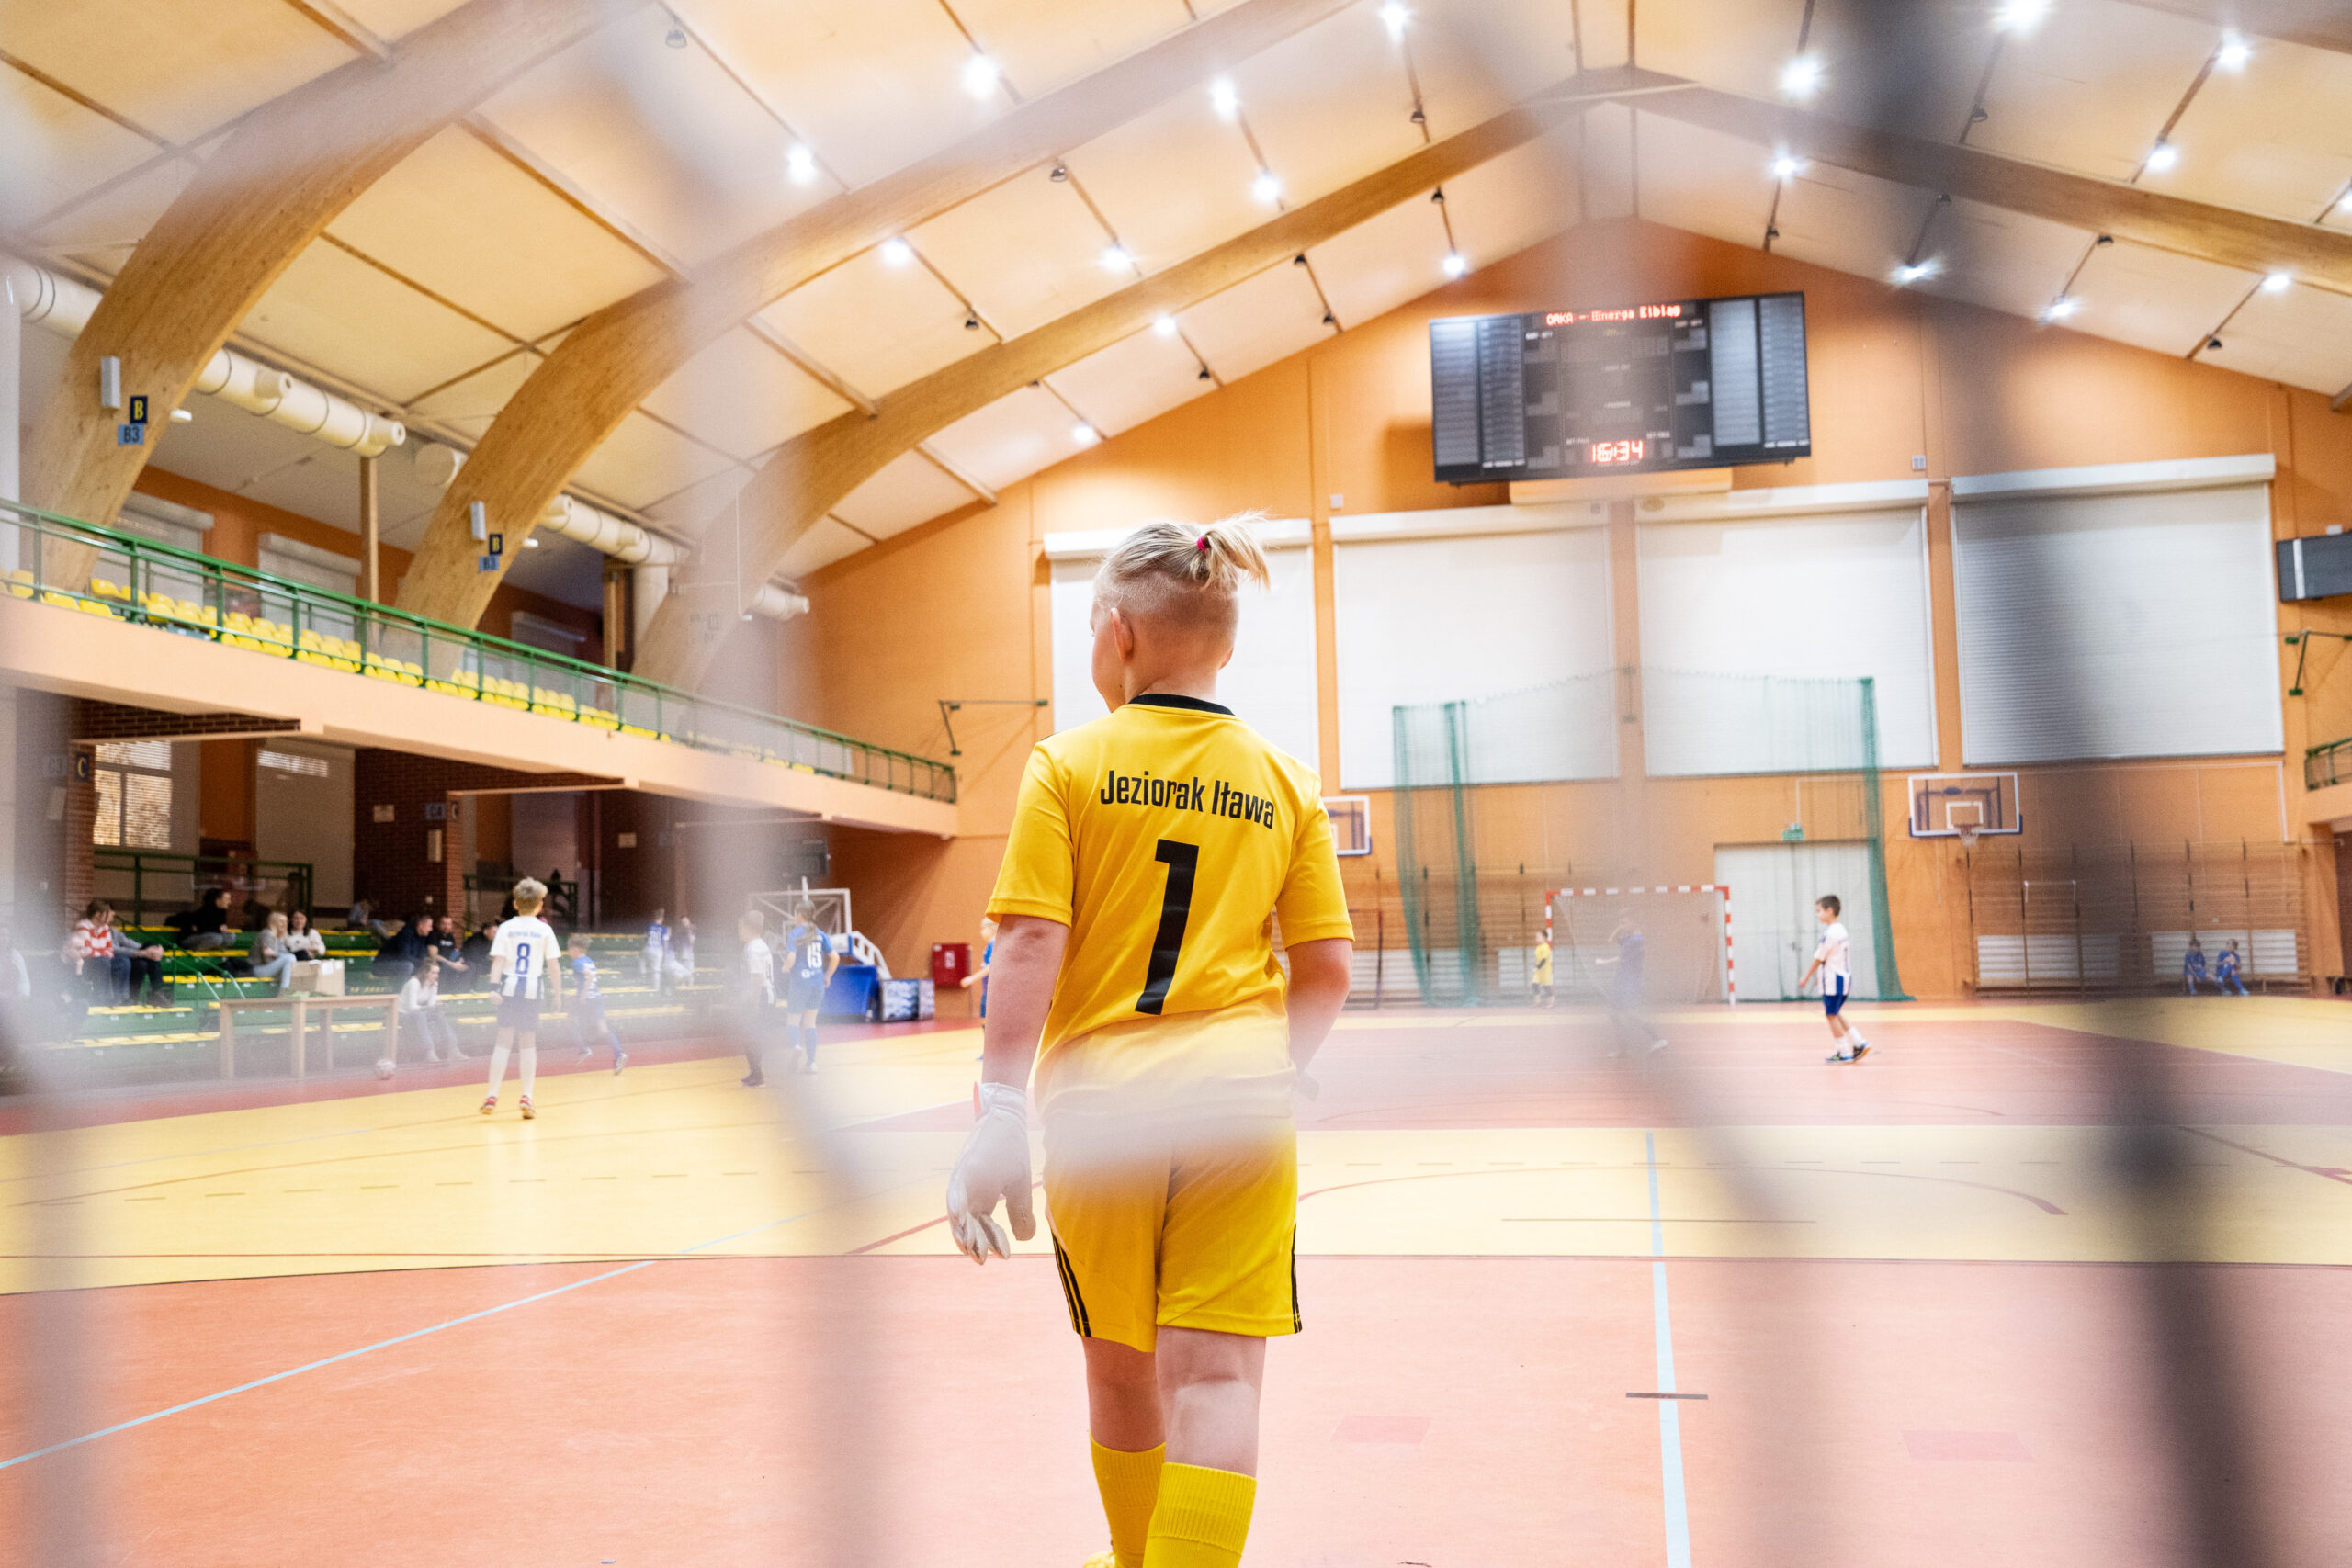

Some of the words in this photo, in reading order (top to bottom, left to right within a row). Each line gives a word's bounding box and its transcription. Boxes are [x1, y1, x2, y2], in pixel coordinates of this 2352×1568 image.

[1546, 312, 1574, 326] ORKA
[134, 400, 144, 420] B
[124, 425, 140, 443] B3
[1591, 440, 1644, 463] 16:34
[492, 536, 500, 552] B
[78, 757, 87, 778] C
[1100, 770, 1206, 812] Jeziorak
[1211, 780, 1274, 829] Iława
[1135, 839, 1199, 1015] 1
[515, 942, 530, 975] 8
